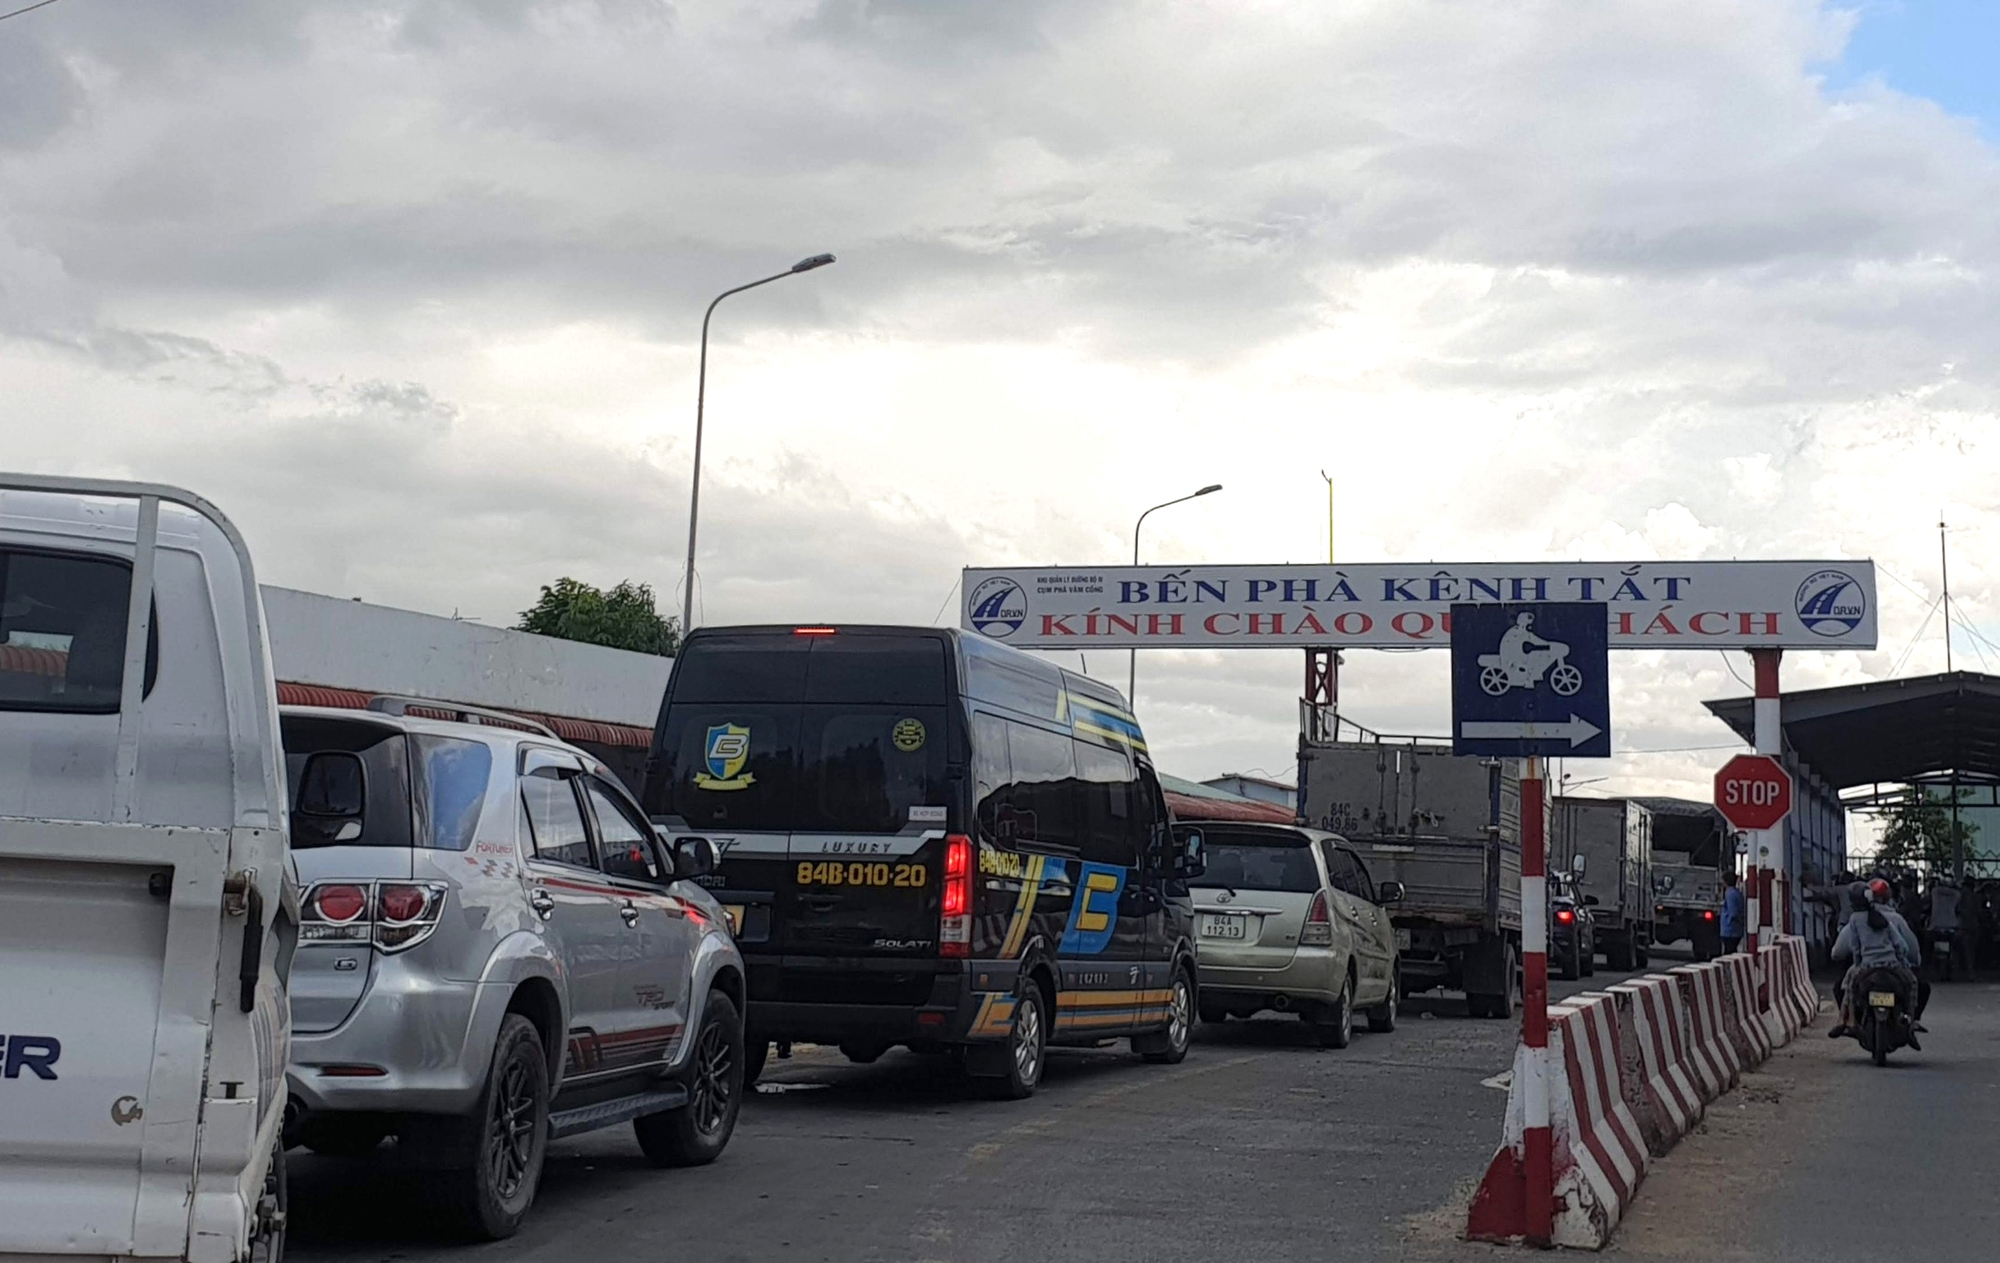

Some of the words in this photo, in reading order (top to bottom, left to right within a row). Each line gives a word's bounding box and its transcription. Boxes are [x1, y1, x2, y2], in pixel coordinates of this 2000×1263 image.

[1053, 585, 1067, 593] PHÀ
[1117, 569, 1229, 603] BẾN
[1244, 571, 1362, 602] PHÀ
[1380, 570, 1551, 601] KÊNH
[1567, 564, 1691, 601] TẮT
[1037, 607, 1186, 636] KÍNH
[1203, 605, 1373, 635] CHÀO
[1725, 779, 1780, 806] STOP
[1330, 802, 1351, 817] 84C
[821, 842, 892, 853] LUXURY
[1213, 915, 1233, 926] 84A
[873, 938, 932, 949] SOLATI
